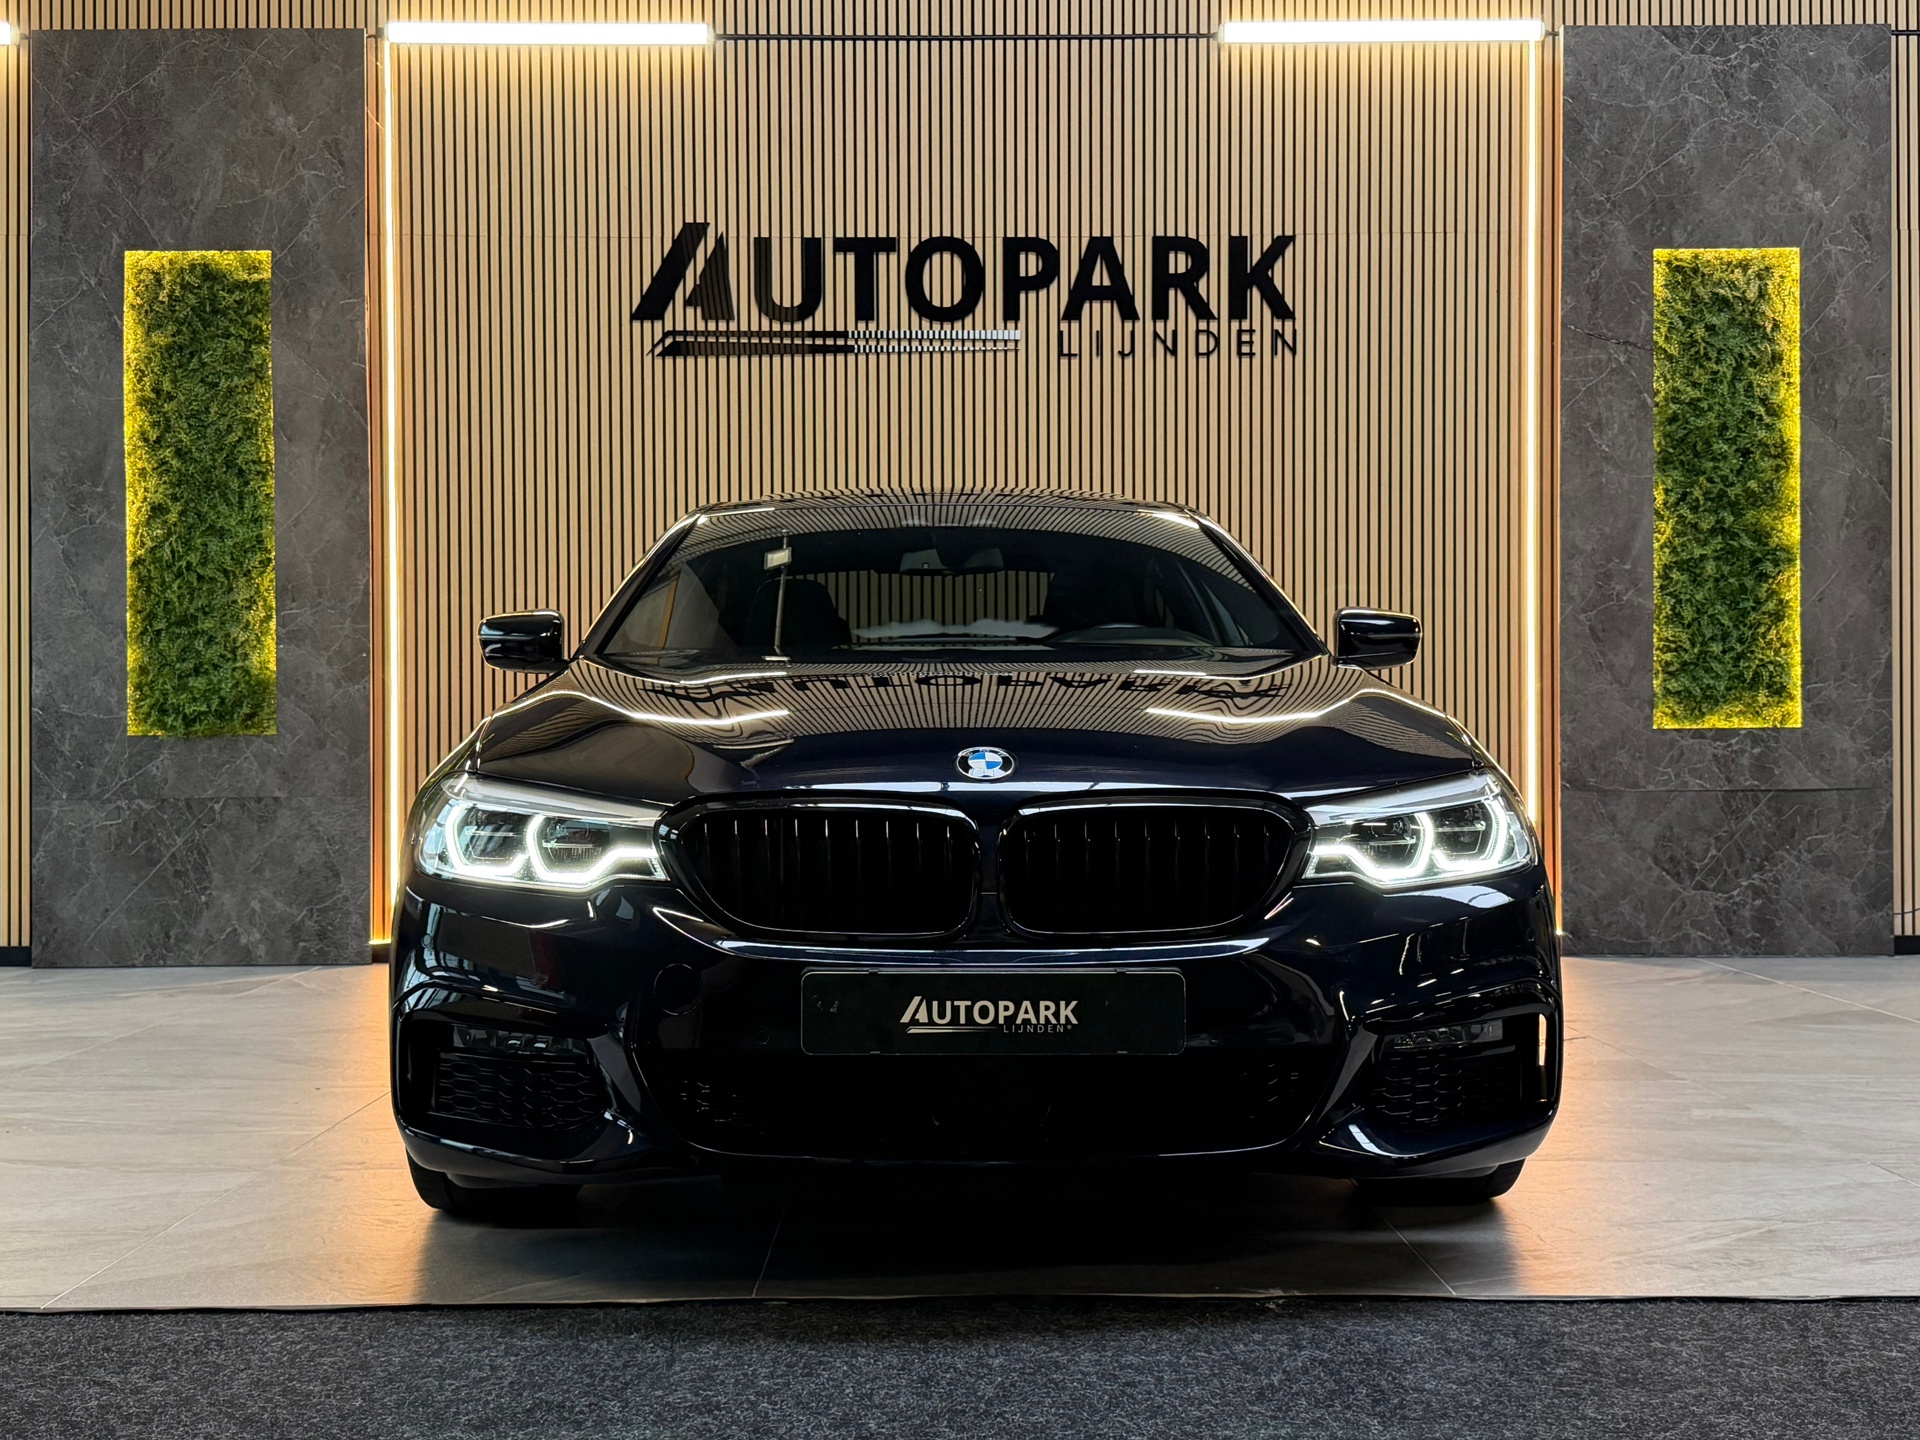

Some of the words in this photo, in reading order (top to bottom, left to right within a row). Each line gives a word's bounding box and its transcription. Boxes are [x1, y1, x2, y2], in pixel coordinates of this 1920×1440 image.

[631, 222, 1296, 322] AUTOPARK
[1058, 328, 1298, 358] LIJNDEN
[900, 995, 1079, 1025] AUTOPARK
